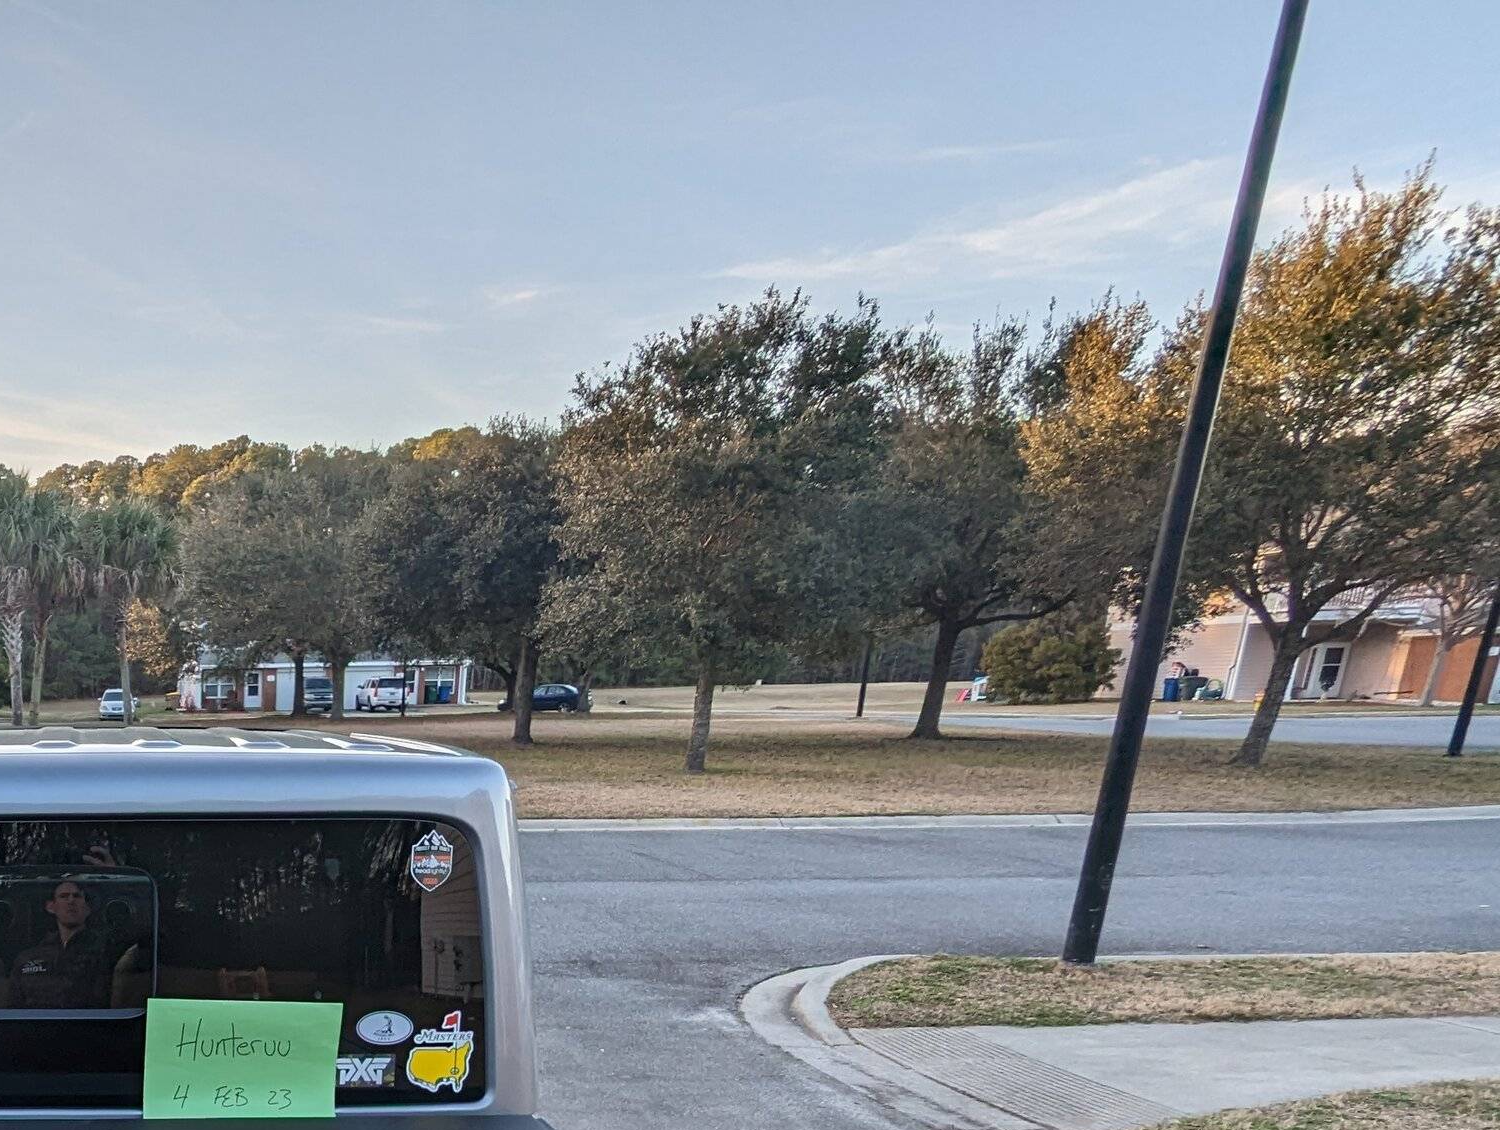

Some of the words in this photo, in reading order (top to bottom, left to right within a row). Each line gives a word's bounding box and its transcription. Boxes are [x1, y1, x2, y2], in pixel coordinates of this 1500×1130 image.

[173, 1084, 190, 1109] 4
[214, 1085, 250, 1109] FEB
[268, 1089, 292, 1110] 23
